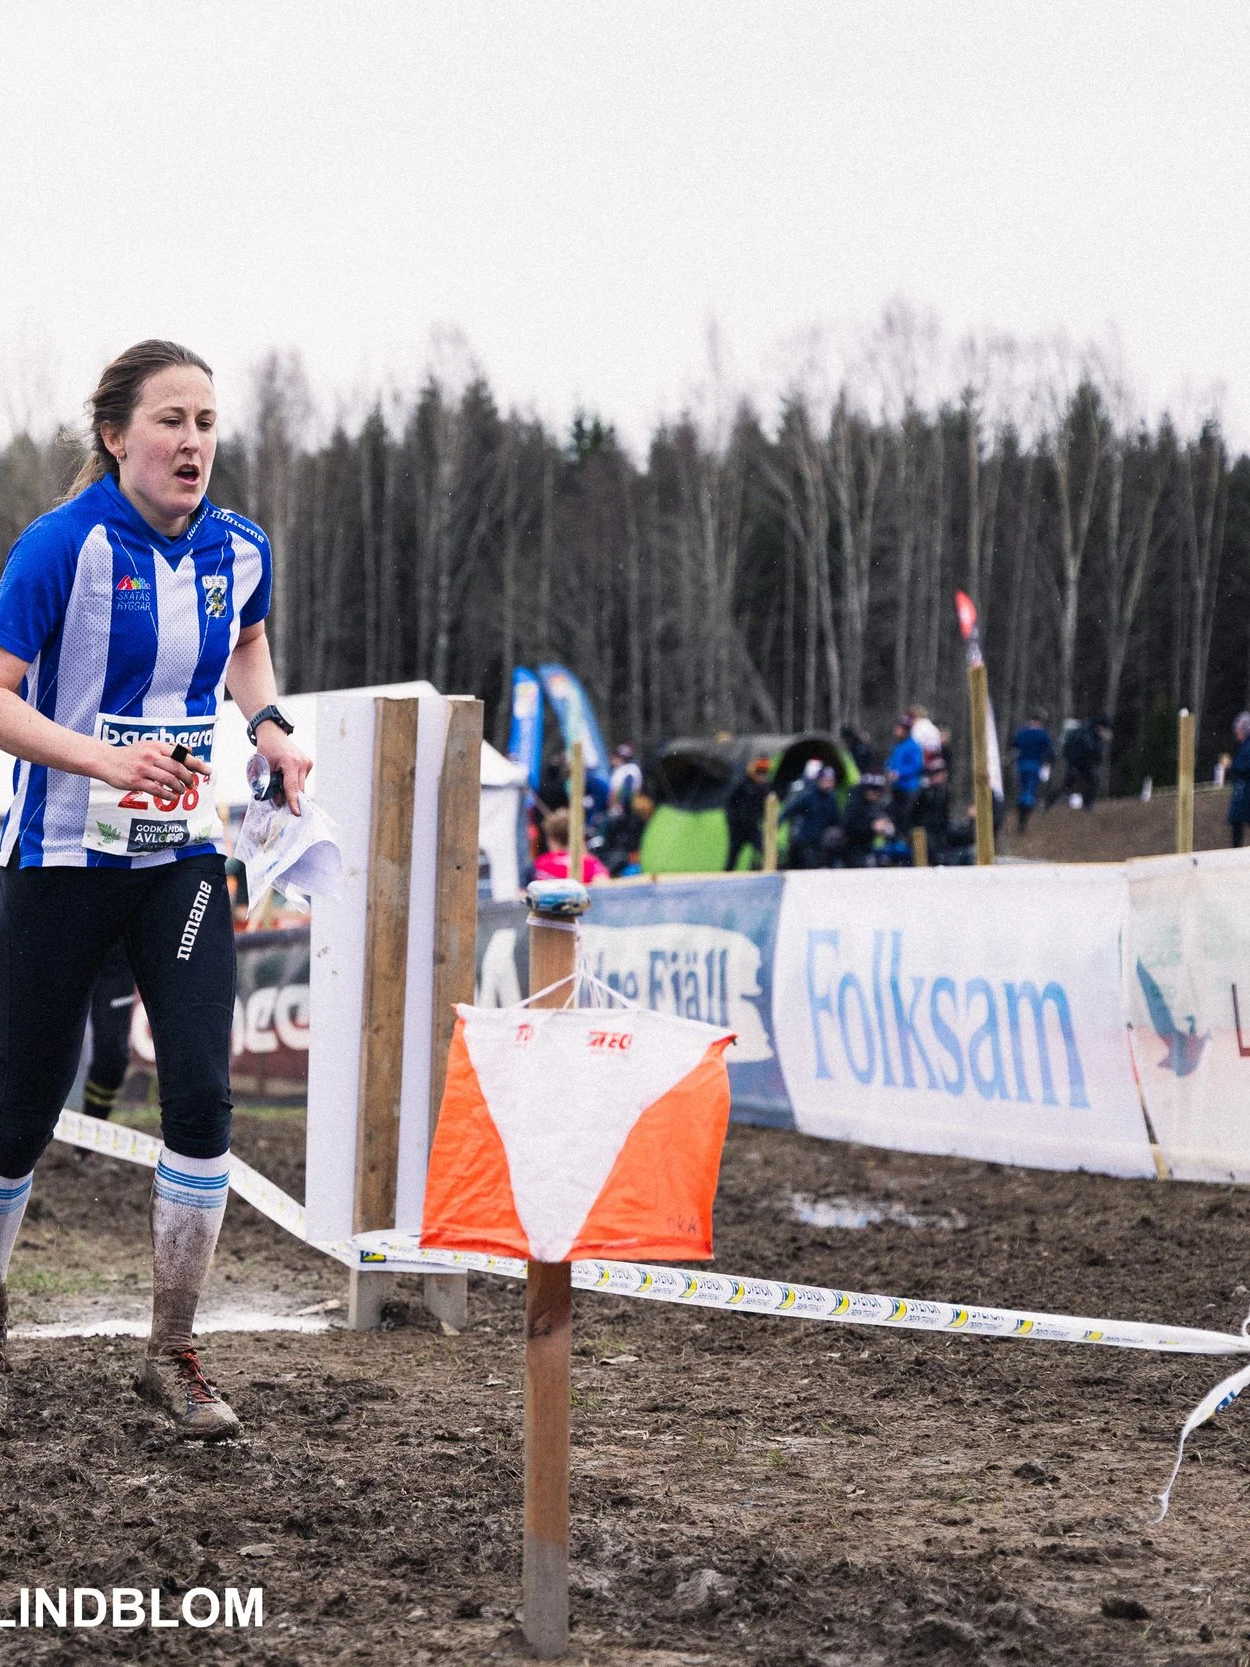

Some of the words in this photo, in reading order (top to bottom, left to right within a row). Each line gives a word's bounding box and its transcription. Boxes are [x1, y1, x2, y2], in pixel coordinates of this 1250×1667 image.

[176, 880, 212, 961] noname
[648, 950, 729, 1027] Fjäll
[806, 929, 1091, 1109] Folksam
